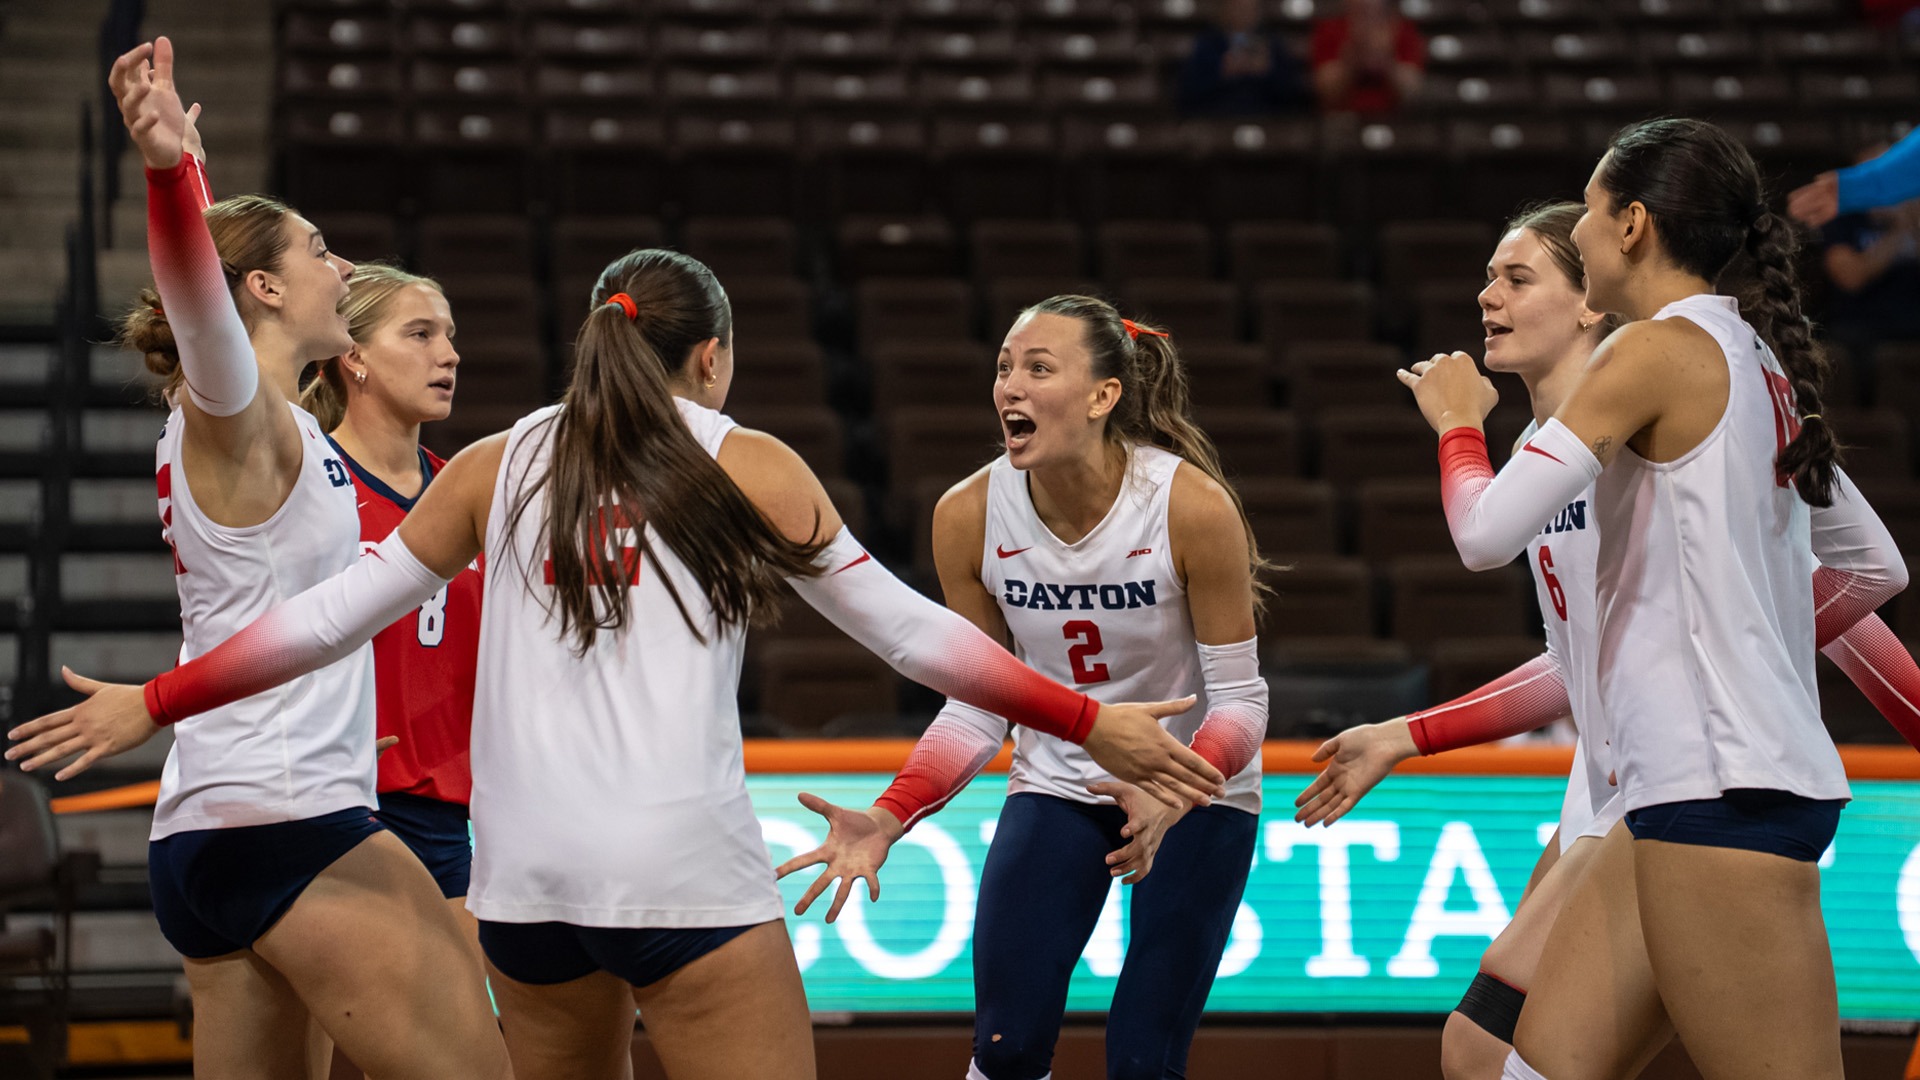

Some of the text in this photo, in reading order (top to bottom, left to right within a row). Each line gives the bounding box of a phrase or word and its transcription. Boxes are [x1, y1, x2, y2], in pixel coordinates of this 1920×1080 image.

[417, 583, 448, 647] 8
[1003, 578, 1157, 610] DAYTON
[1538, 545, 1568, 622] 6
[1062, 620, 1111, 684] 2
